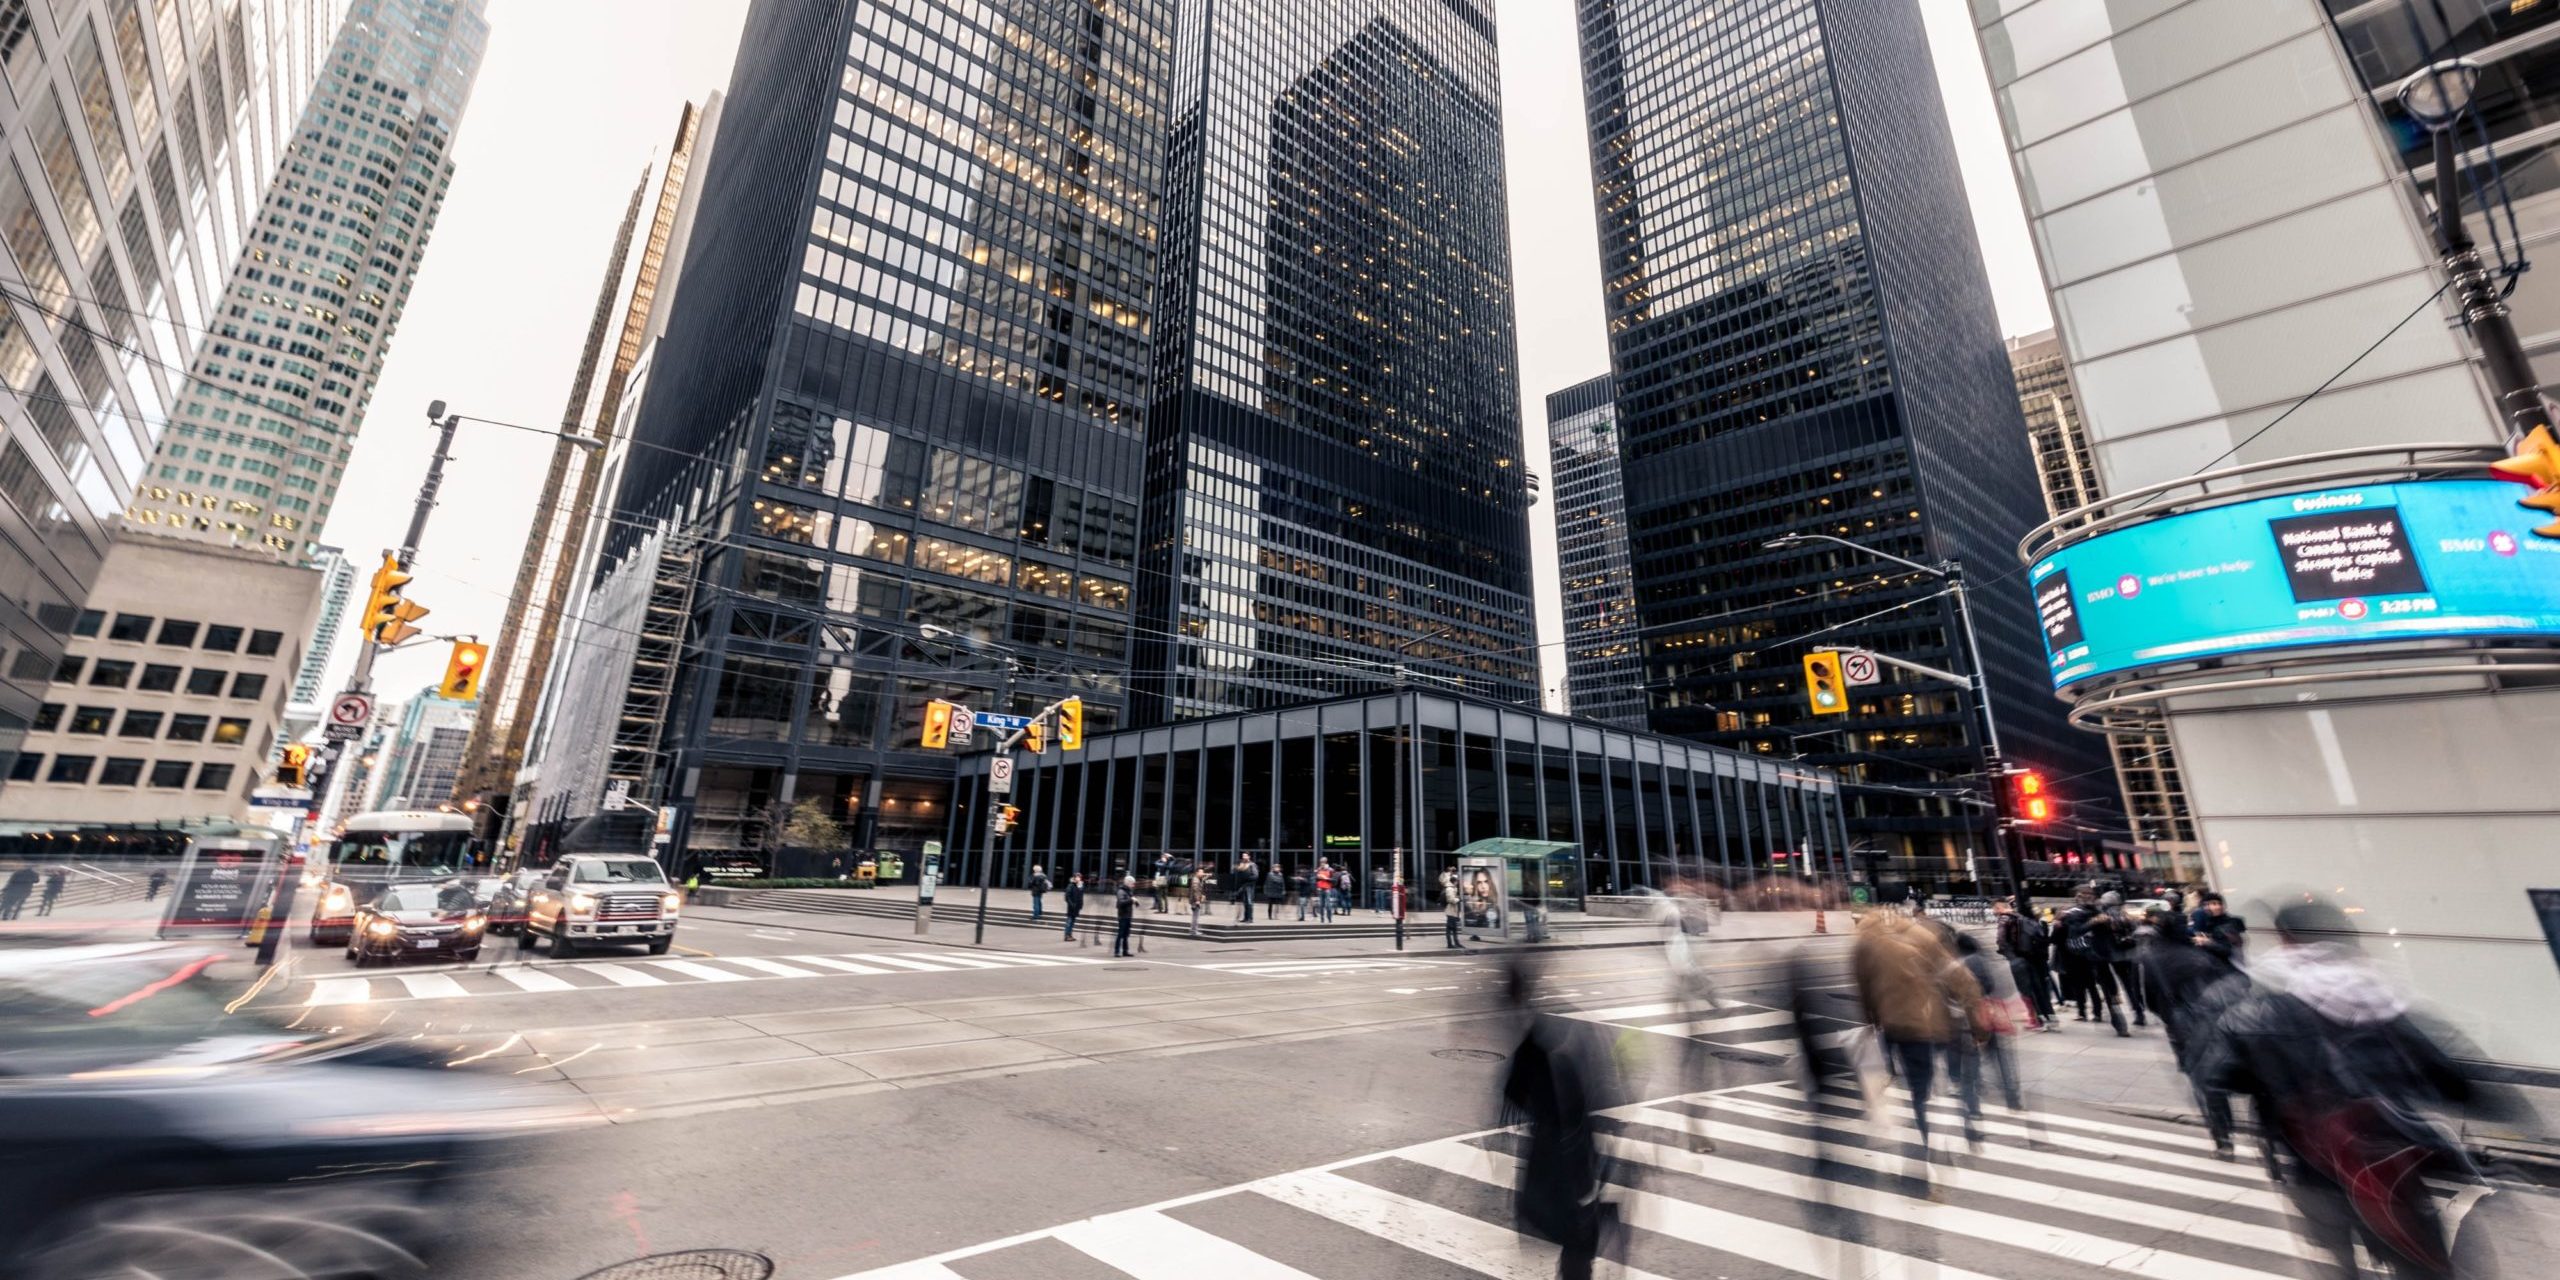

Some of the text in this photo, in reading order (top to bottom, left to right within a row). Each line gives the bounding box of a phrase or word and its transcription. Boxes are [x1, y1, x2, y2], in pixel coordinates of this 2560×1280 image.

[2292, 493, 2364, 512] Business
[2282, 521, 2394, 546] National Bank of
[2296, 537, 2392, 558] Canada wants
[2439, 538, 2485, 553] BMO
[2294, 549, 2403, 573] stronger capital
[2147, 573, 2177, 586] We're
[2178, 567, 2204, 581] here
[2206, 565, 2219, 576] to
[2087, 587, 2115, 604] BMO
[2412, 598, 2437, 612] PM
[987, 715, 1006, 728] King
[1012, 717, 1020, 727] W
